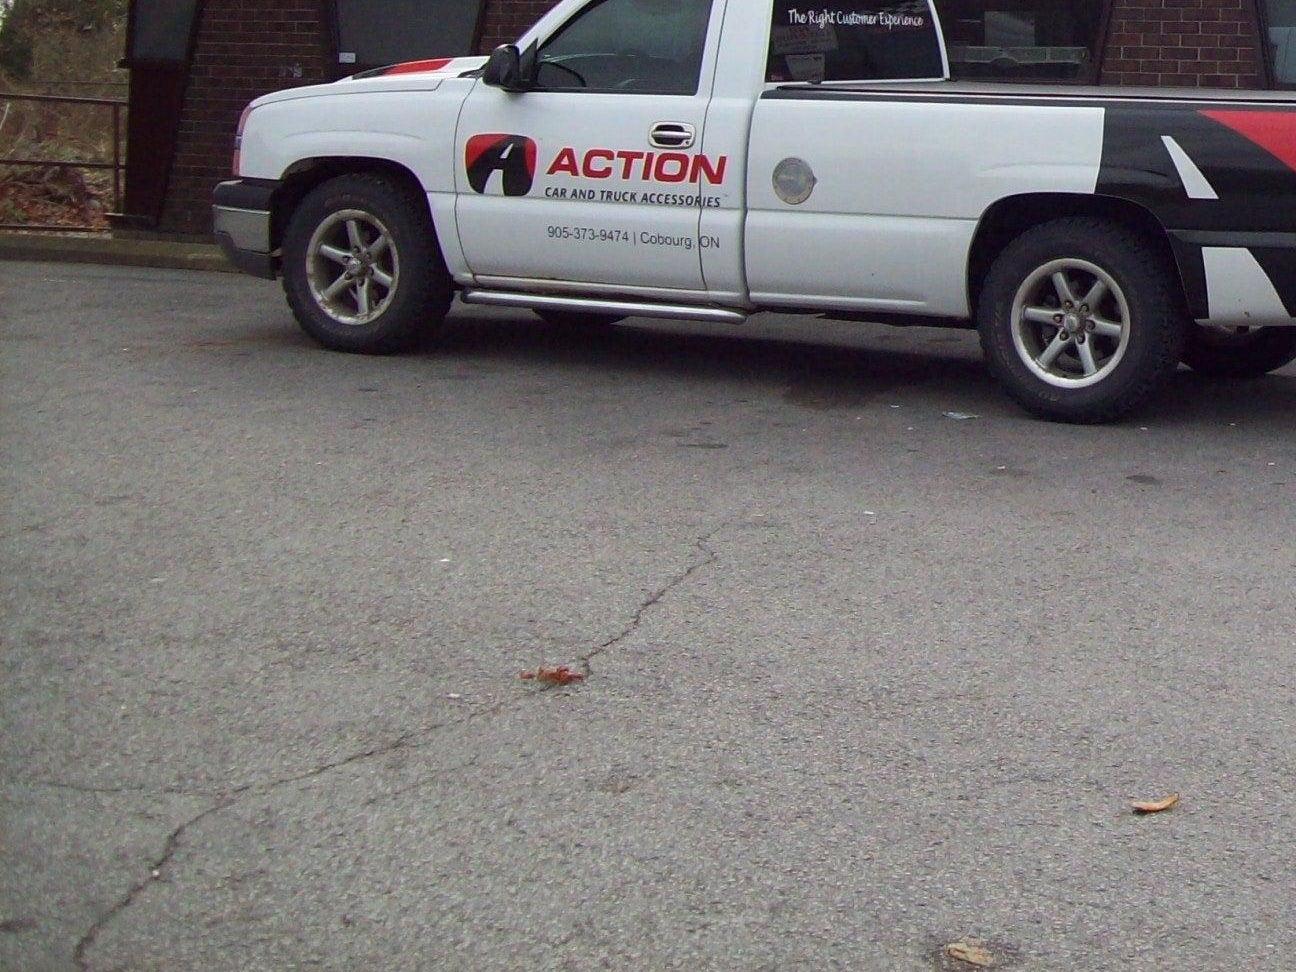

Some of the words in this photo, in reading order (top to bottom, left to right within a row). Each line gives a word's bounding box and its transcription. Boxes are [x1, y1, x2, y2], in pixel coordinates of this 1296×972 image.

[788, 8, 807, 25] The
[808, 9, 836, 29] Right
[837, 11, 878, 26] Customer
[879, 12, 924, 30] Experience
[546, 147, 728, 185] ACTION
[545, 186, 567, 198] CAR
[570, 188, 596, 200] AND
[600, 190, 637, 203] TRUCK
[641, 192, 721, 208] ACCESSORIES
[547, 226, 629, 242] 905-373-9474
[640, 231, 696, 250] Cobourg,
[700, 235, 720, 249] ON
